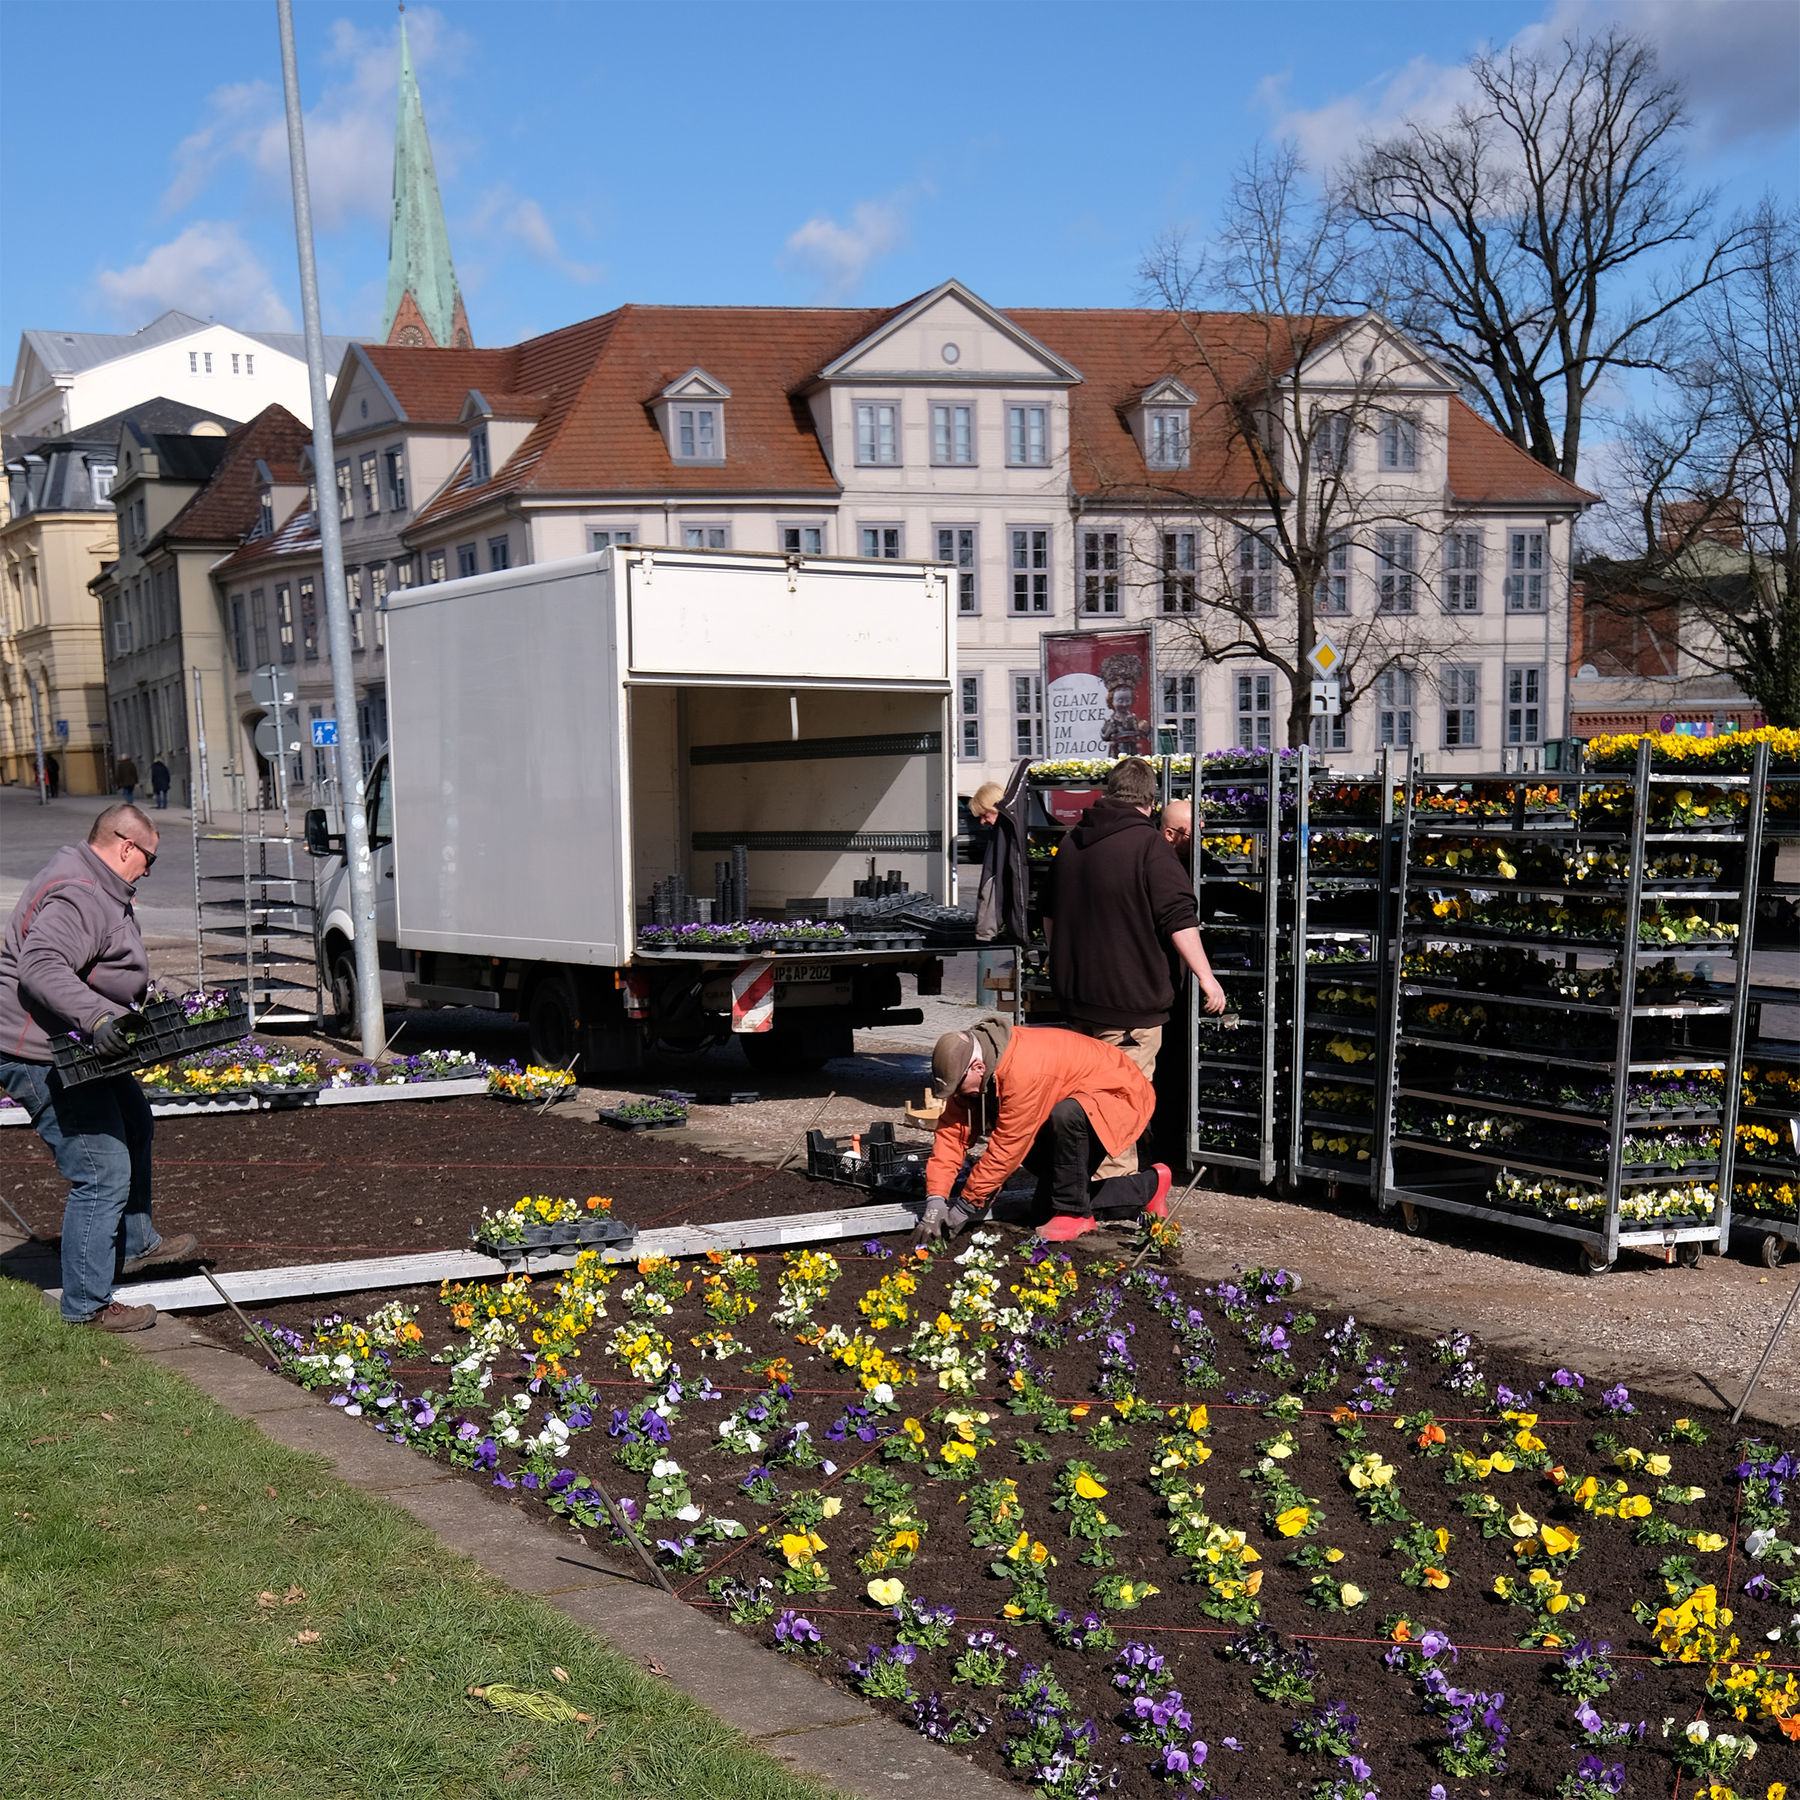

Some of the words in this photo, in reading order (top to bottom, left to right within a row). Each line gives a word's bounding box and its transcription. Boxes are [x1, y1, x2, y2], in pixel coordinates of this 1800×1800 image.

[1053, 692, 1098, 707] GLANZ
[1054, 707, 1106, 723] STÜCKE
[1054, 726, 1072, 739] IM
[1054, 740, 1107, 755] DIALOG
[793, 966, 808, 980] AP
[809, 965, 830, 979] 202
